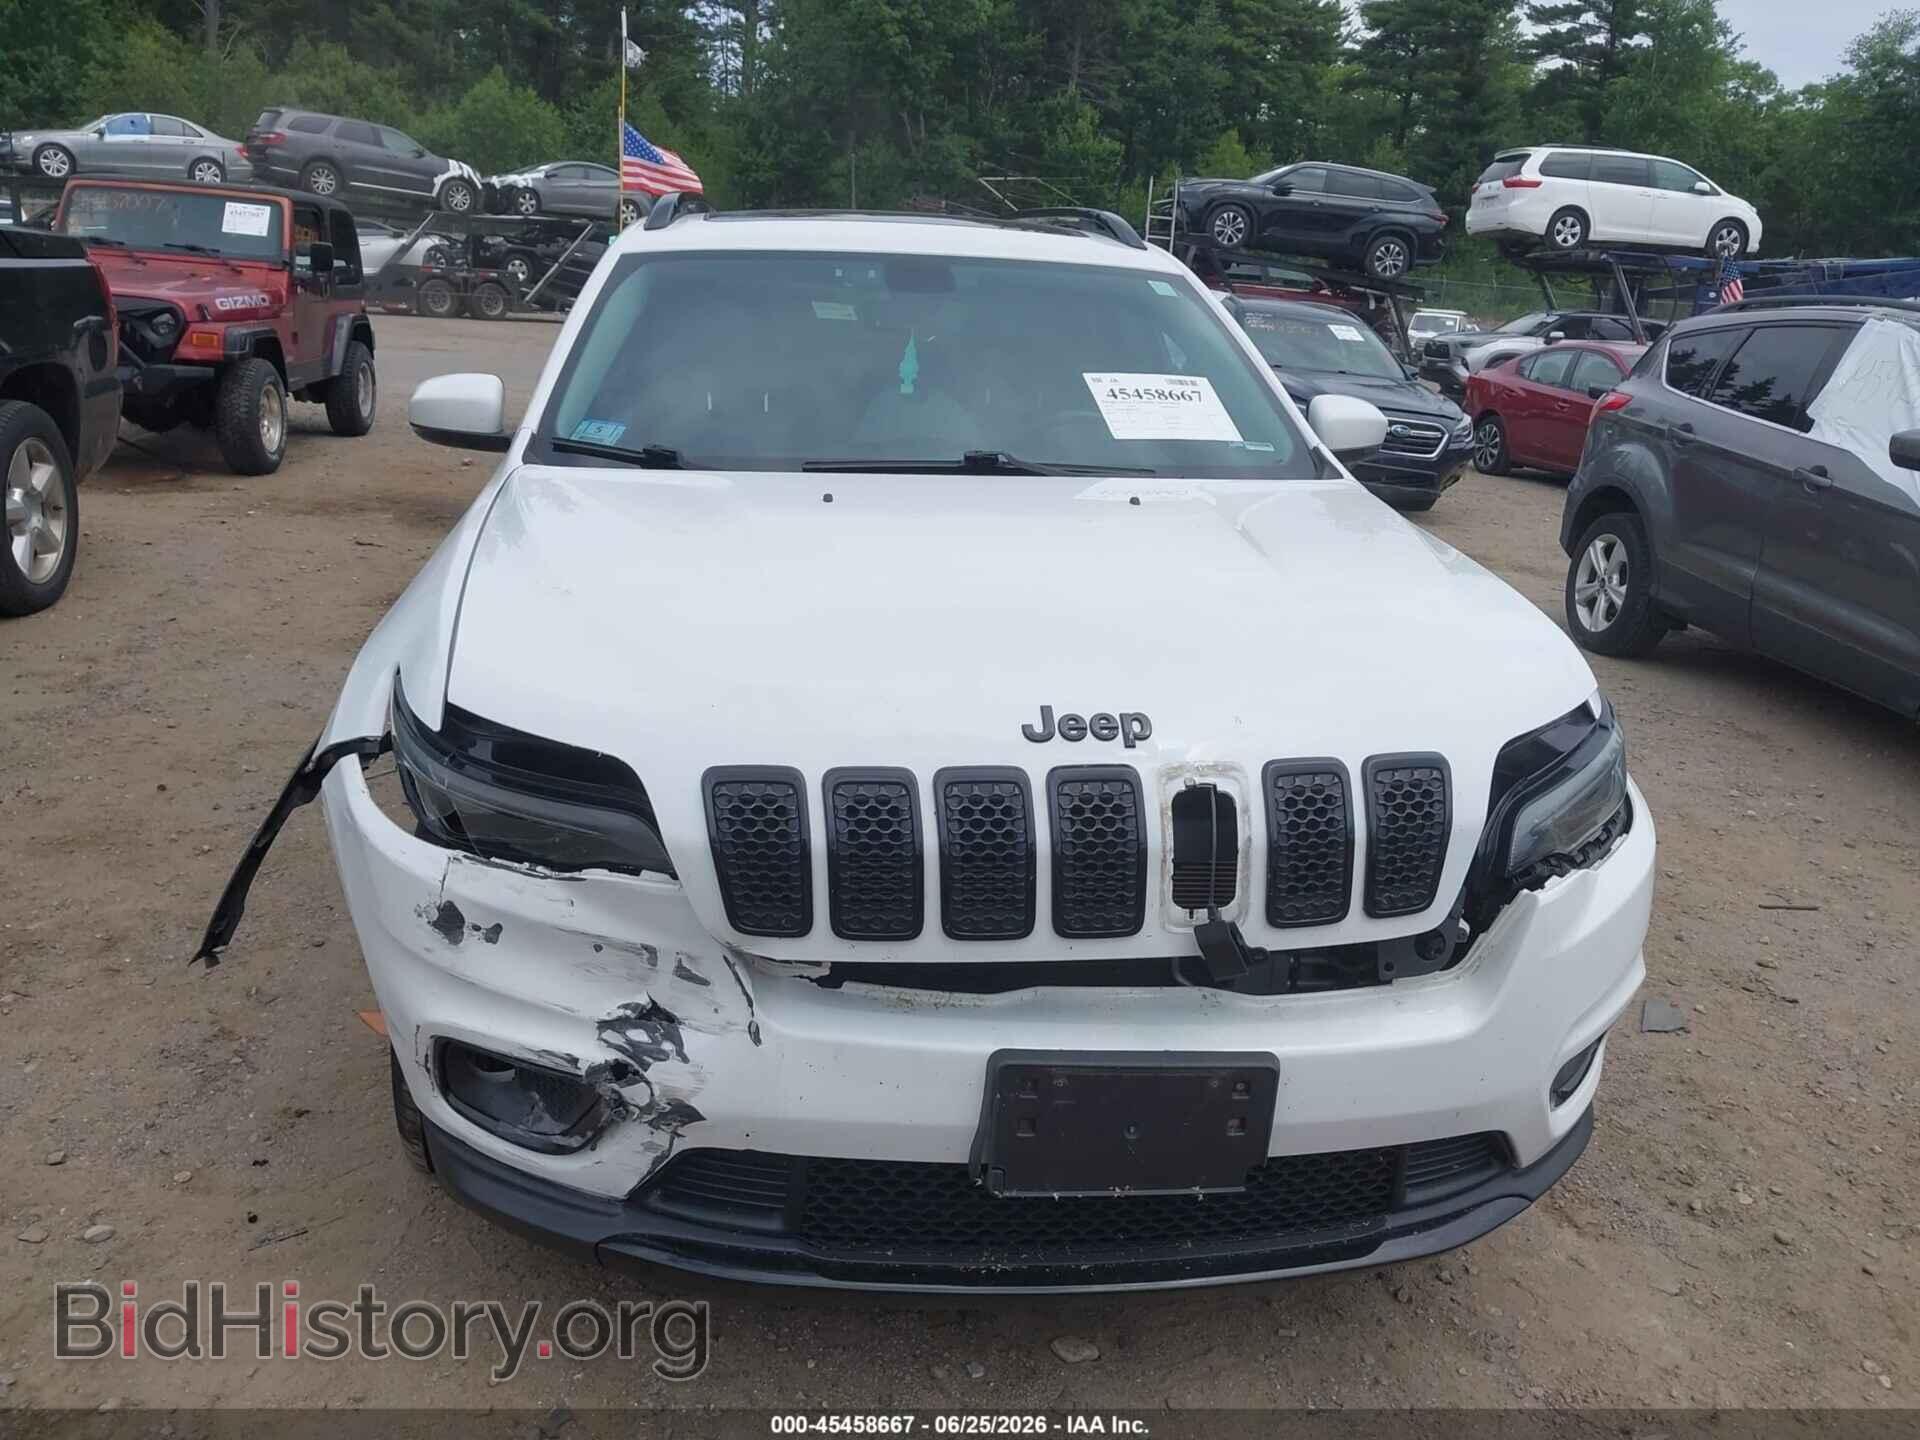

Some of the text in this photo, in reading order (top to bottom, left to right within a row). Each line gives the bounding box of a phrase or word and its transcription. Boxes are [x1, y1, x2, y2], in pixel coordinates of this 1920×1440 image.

[215, 294, 270, 310] GIZMO
[1106, 387, 1202, 402] 45458667
[1021, 705, 1152, 749] Jeep
